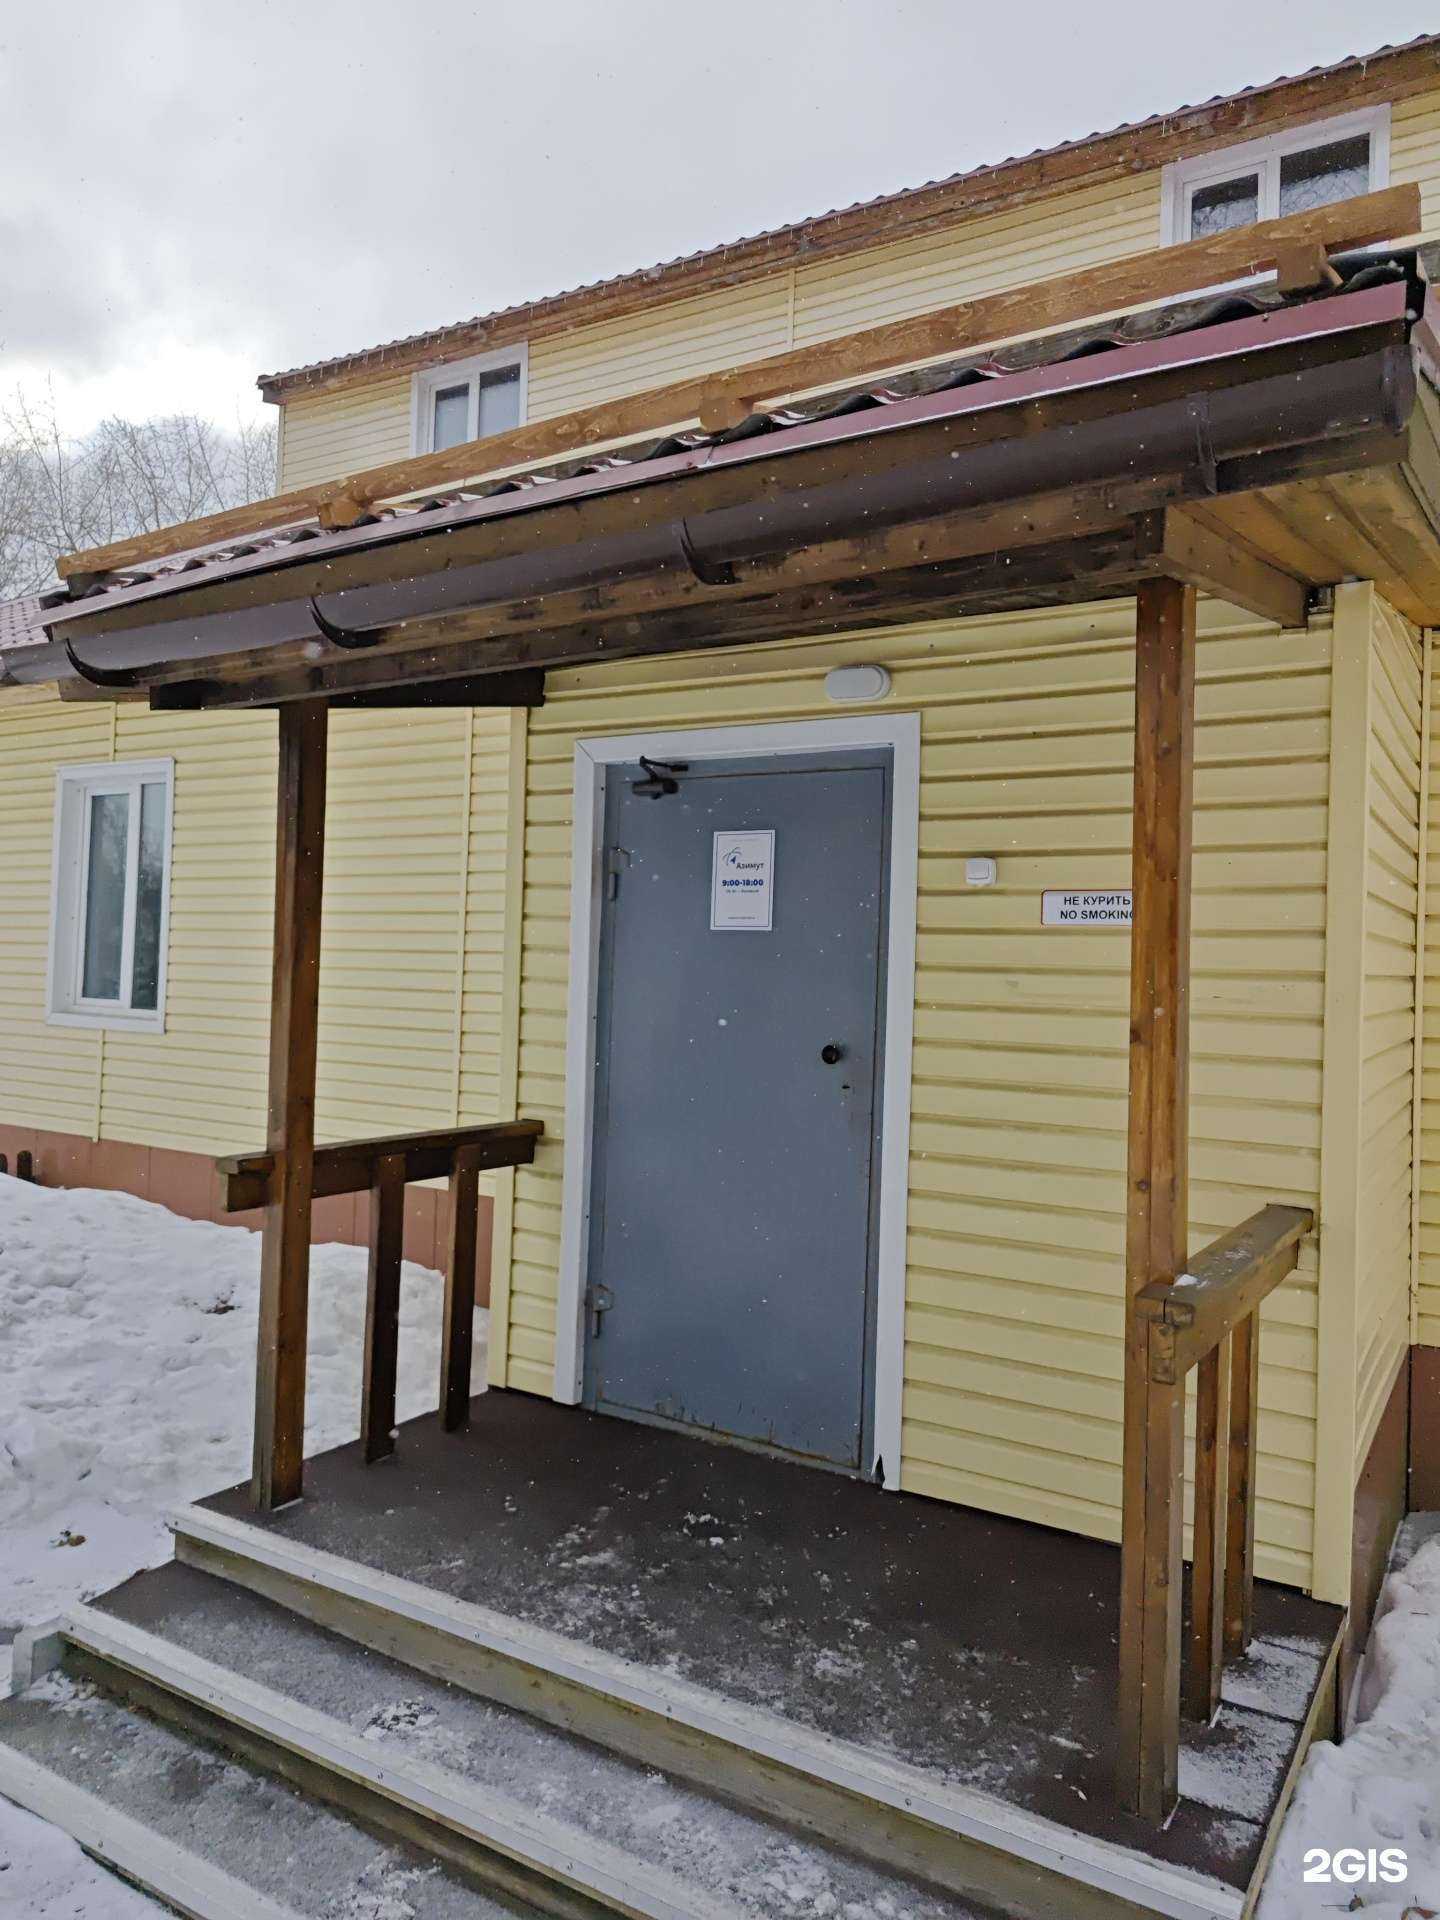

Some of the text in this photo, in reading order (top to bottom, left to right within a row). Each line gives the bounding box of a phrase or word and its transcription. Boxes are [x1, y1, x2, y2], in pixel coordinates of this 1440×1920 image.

[736, 863, 764, 871] Азимут
[722, 879, 764, 887] 9:00-18:00
[1064, 896, 1131, 906] НЕ КУРИТЬ
[1060, 910, 1078, 920] NO
